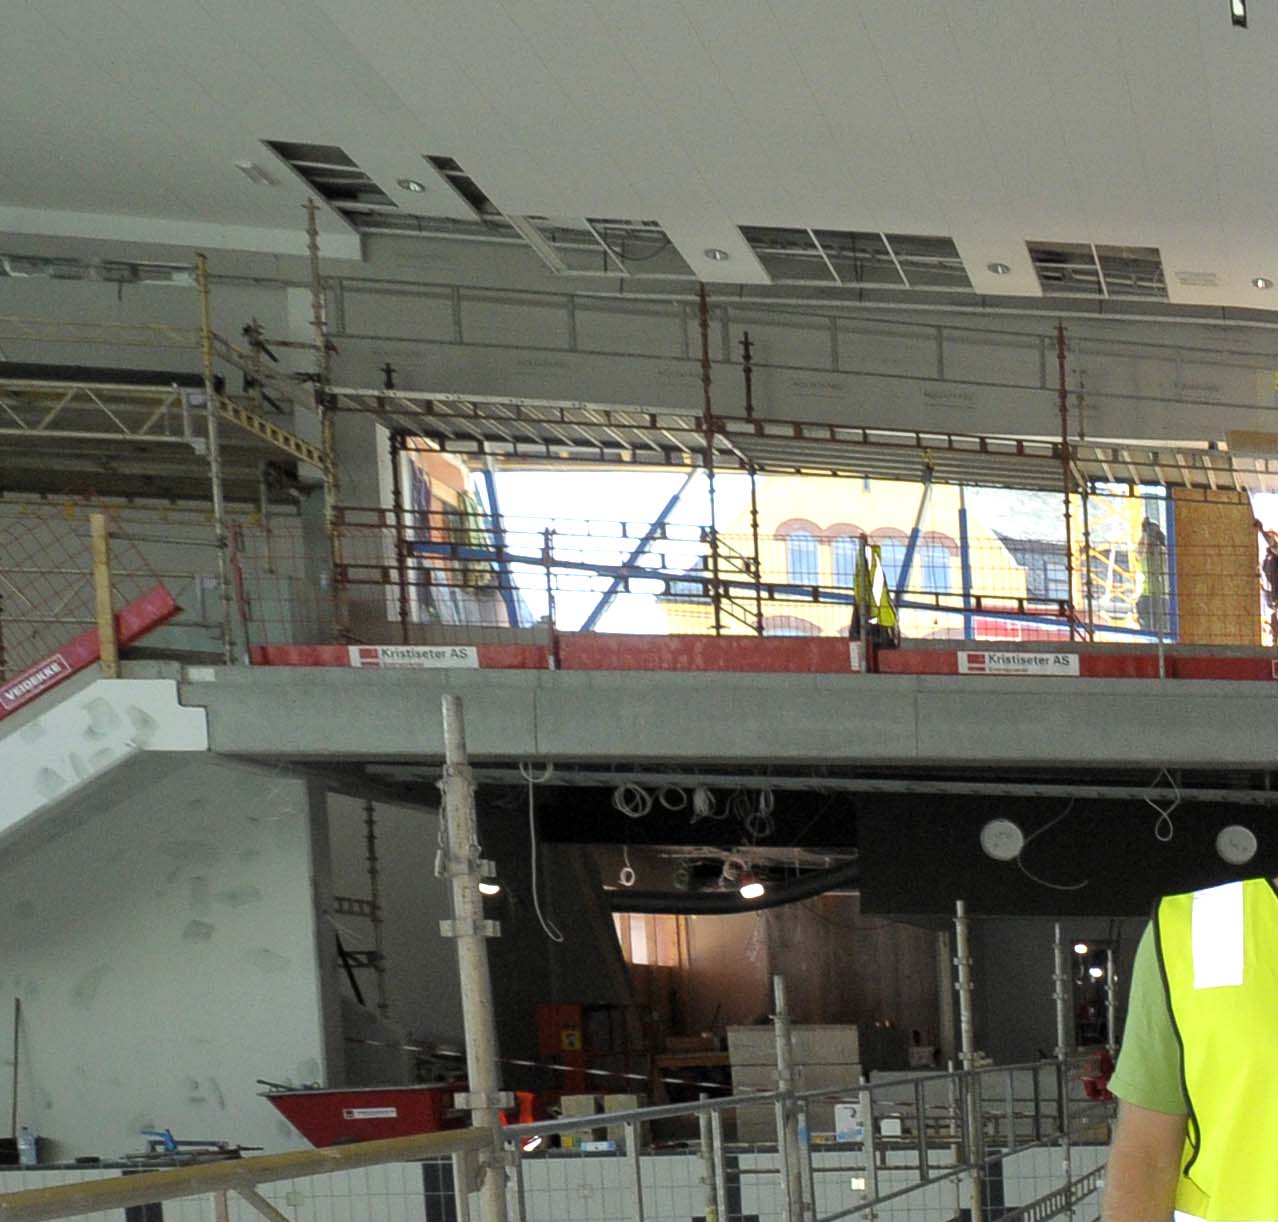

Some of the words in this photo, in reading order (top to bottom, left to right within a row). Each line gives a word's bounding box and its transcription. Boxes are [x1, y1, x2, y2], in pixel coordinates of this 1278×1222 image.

[381, 647, 446, 659] Kristiseter
[450, 648, 468, 659] AS
[988, 653, 1049, 665] Kristiseter
[1053, 655, 1070, 666] AS
[4, 662, 62, 700] VEIDEKKE
